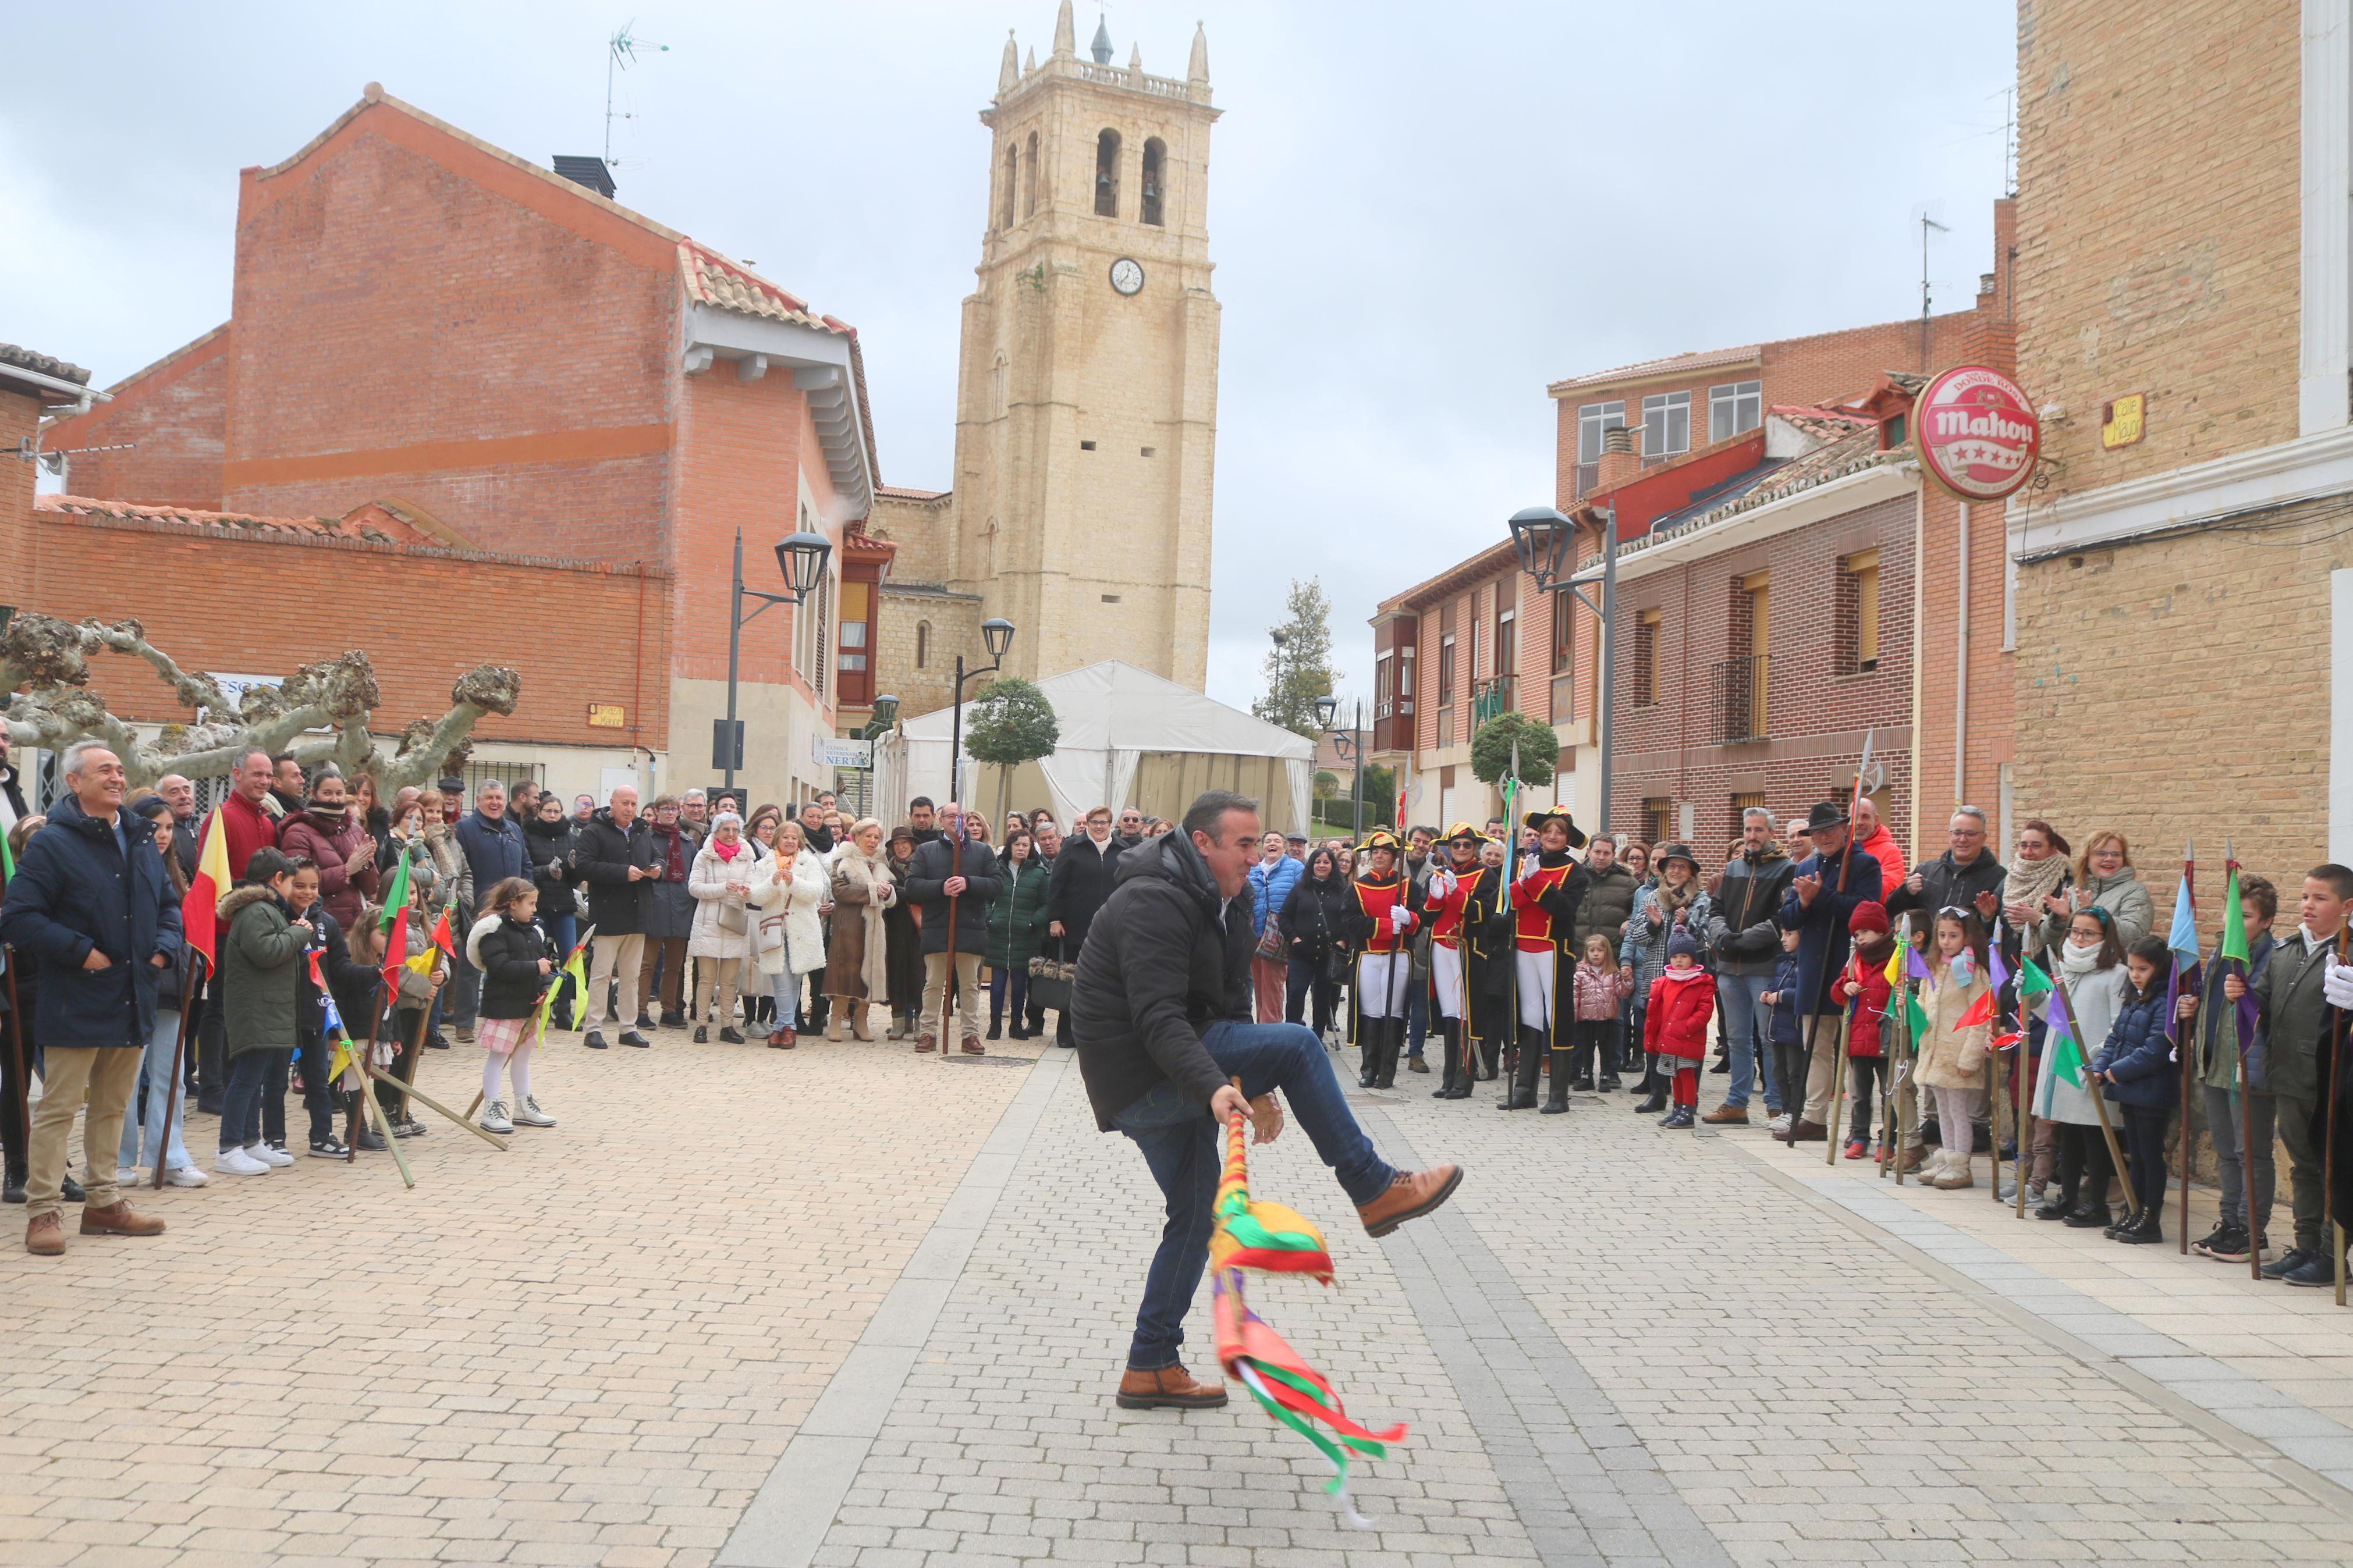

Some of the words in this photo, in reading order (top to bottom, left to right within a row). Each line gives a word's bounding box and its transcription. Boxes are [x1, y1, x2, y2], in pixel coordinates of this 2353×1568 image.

[1954, 375, 1994, 390] DONDE
[2116, 398, 2136, 417] Calle
[1935, 411, 2033, 443] Mahou
[2113, 419, 2141, 441] Mayor
[601, 706, 621, 714] Plaza
[600, 716, 621, 726] Mayor
